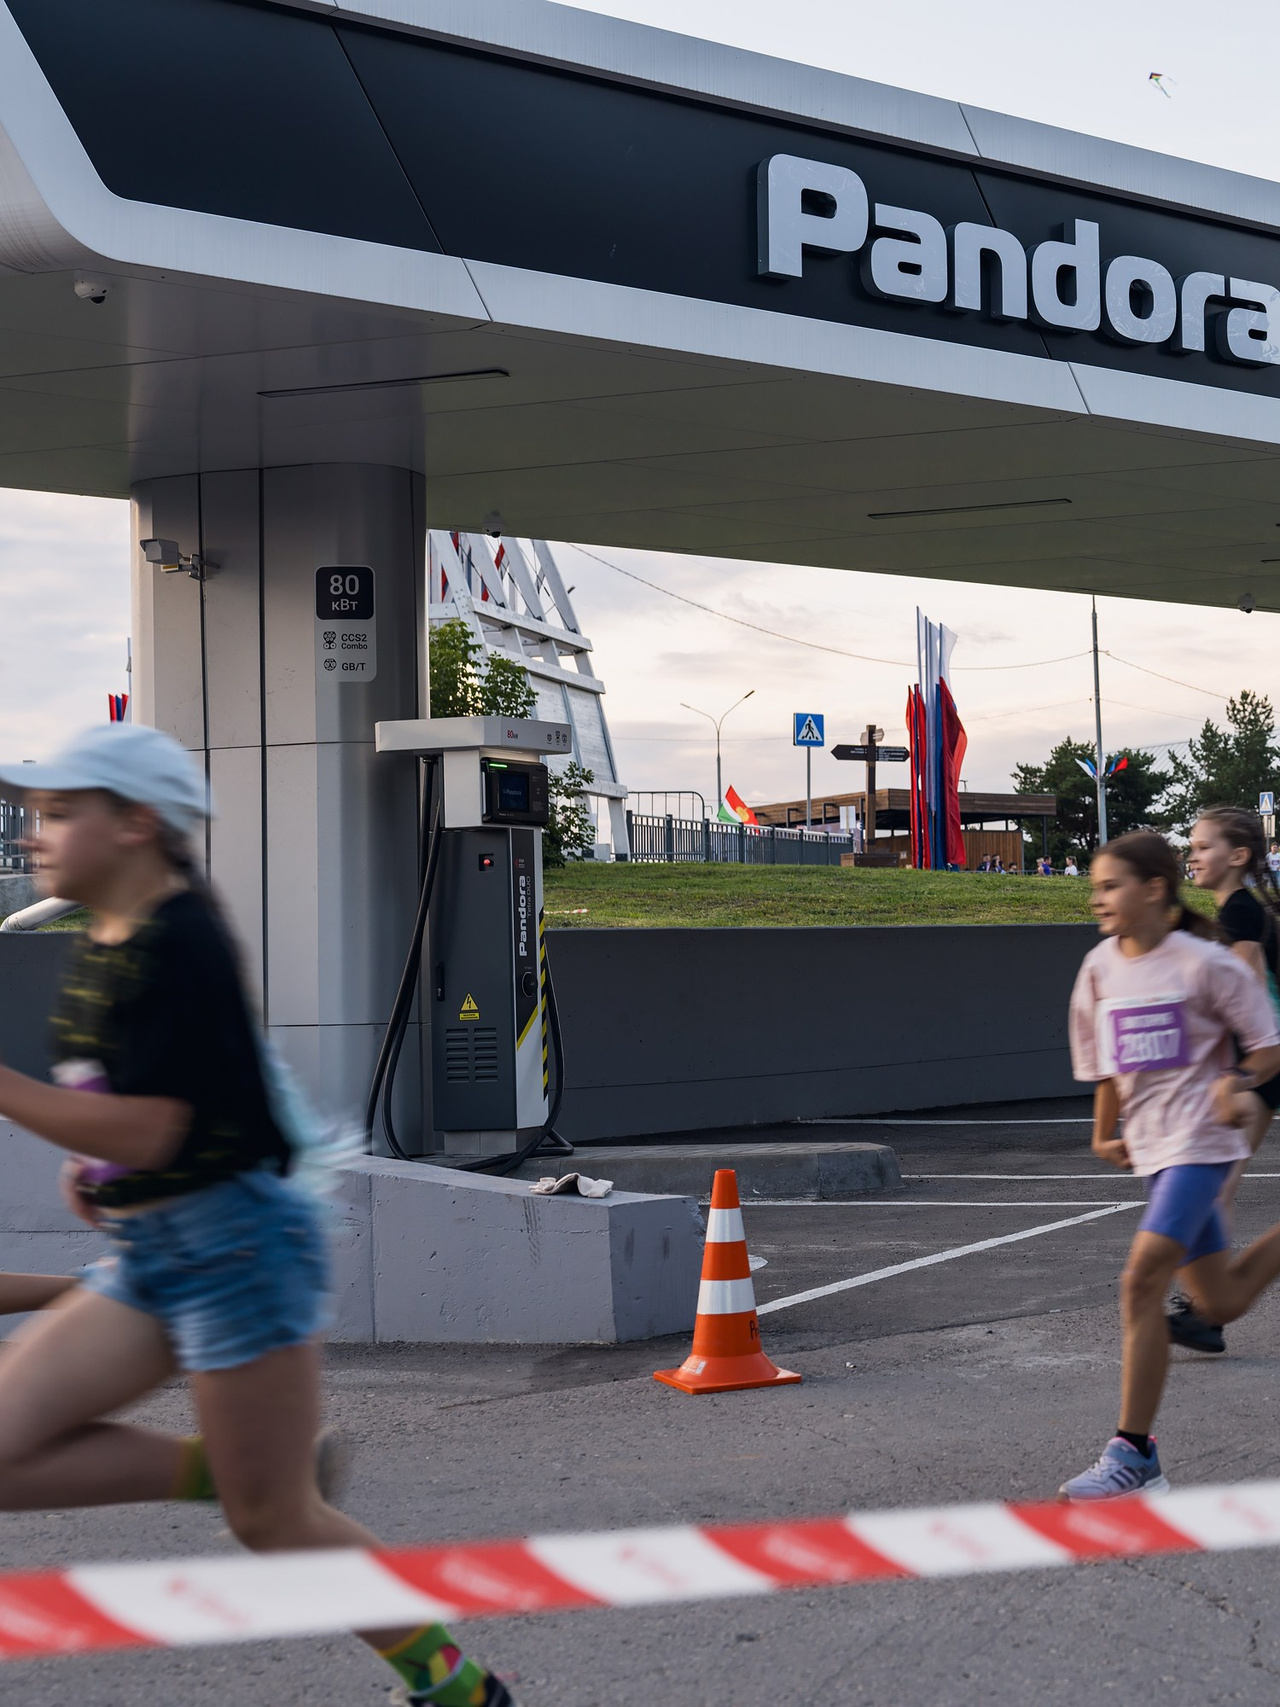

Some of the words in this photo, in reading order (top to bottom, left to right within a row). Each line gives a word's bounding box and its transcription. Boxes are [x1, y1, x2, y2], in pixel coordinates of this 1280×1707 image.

[329, 574, 359, 596] 80
[331, 598, 358, 611] кВт
[341, 633, 367, 642] CCS2
[341, 642, 368, 650] Combo
[341, 661, 366, 671] GB/T
[518, 875, 527, 957] Pandora
